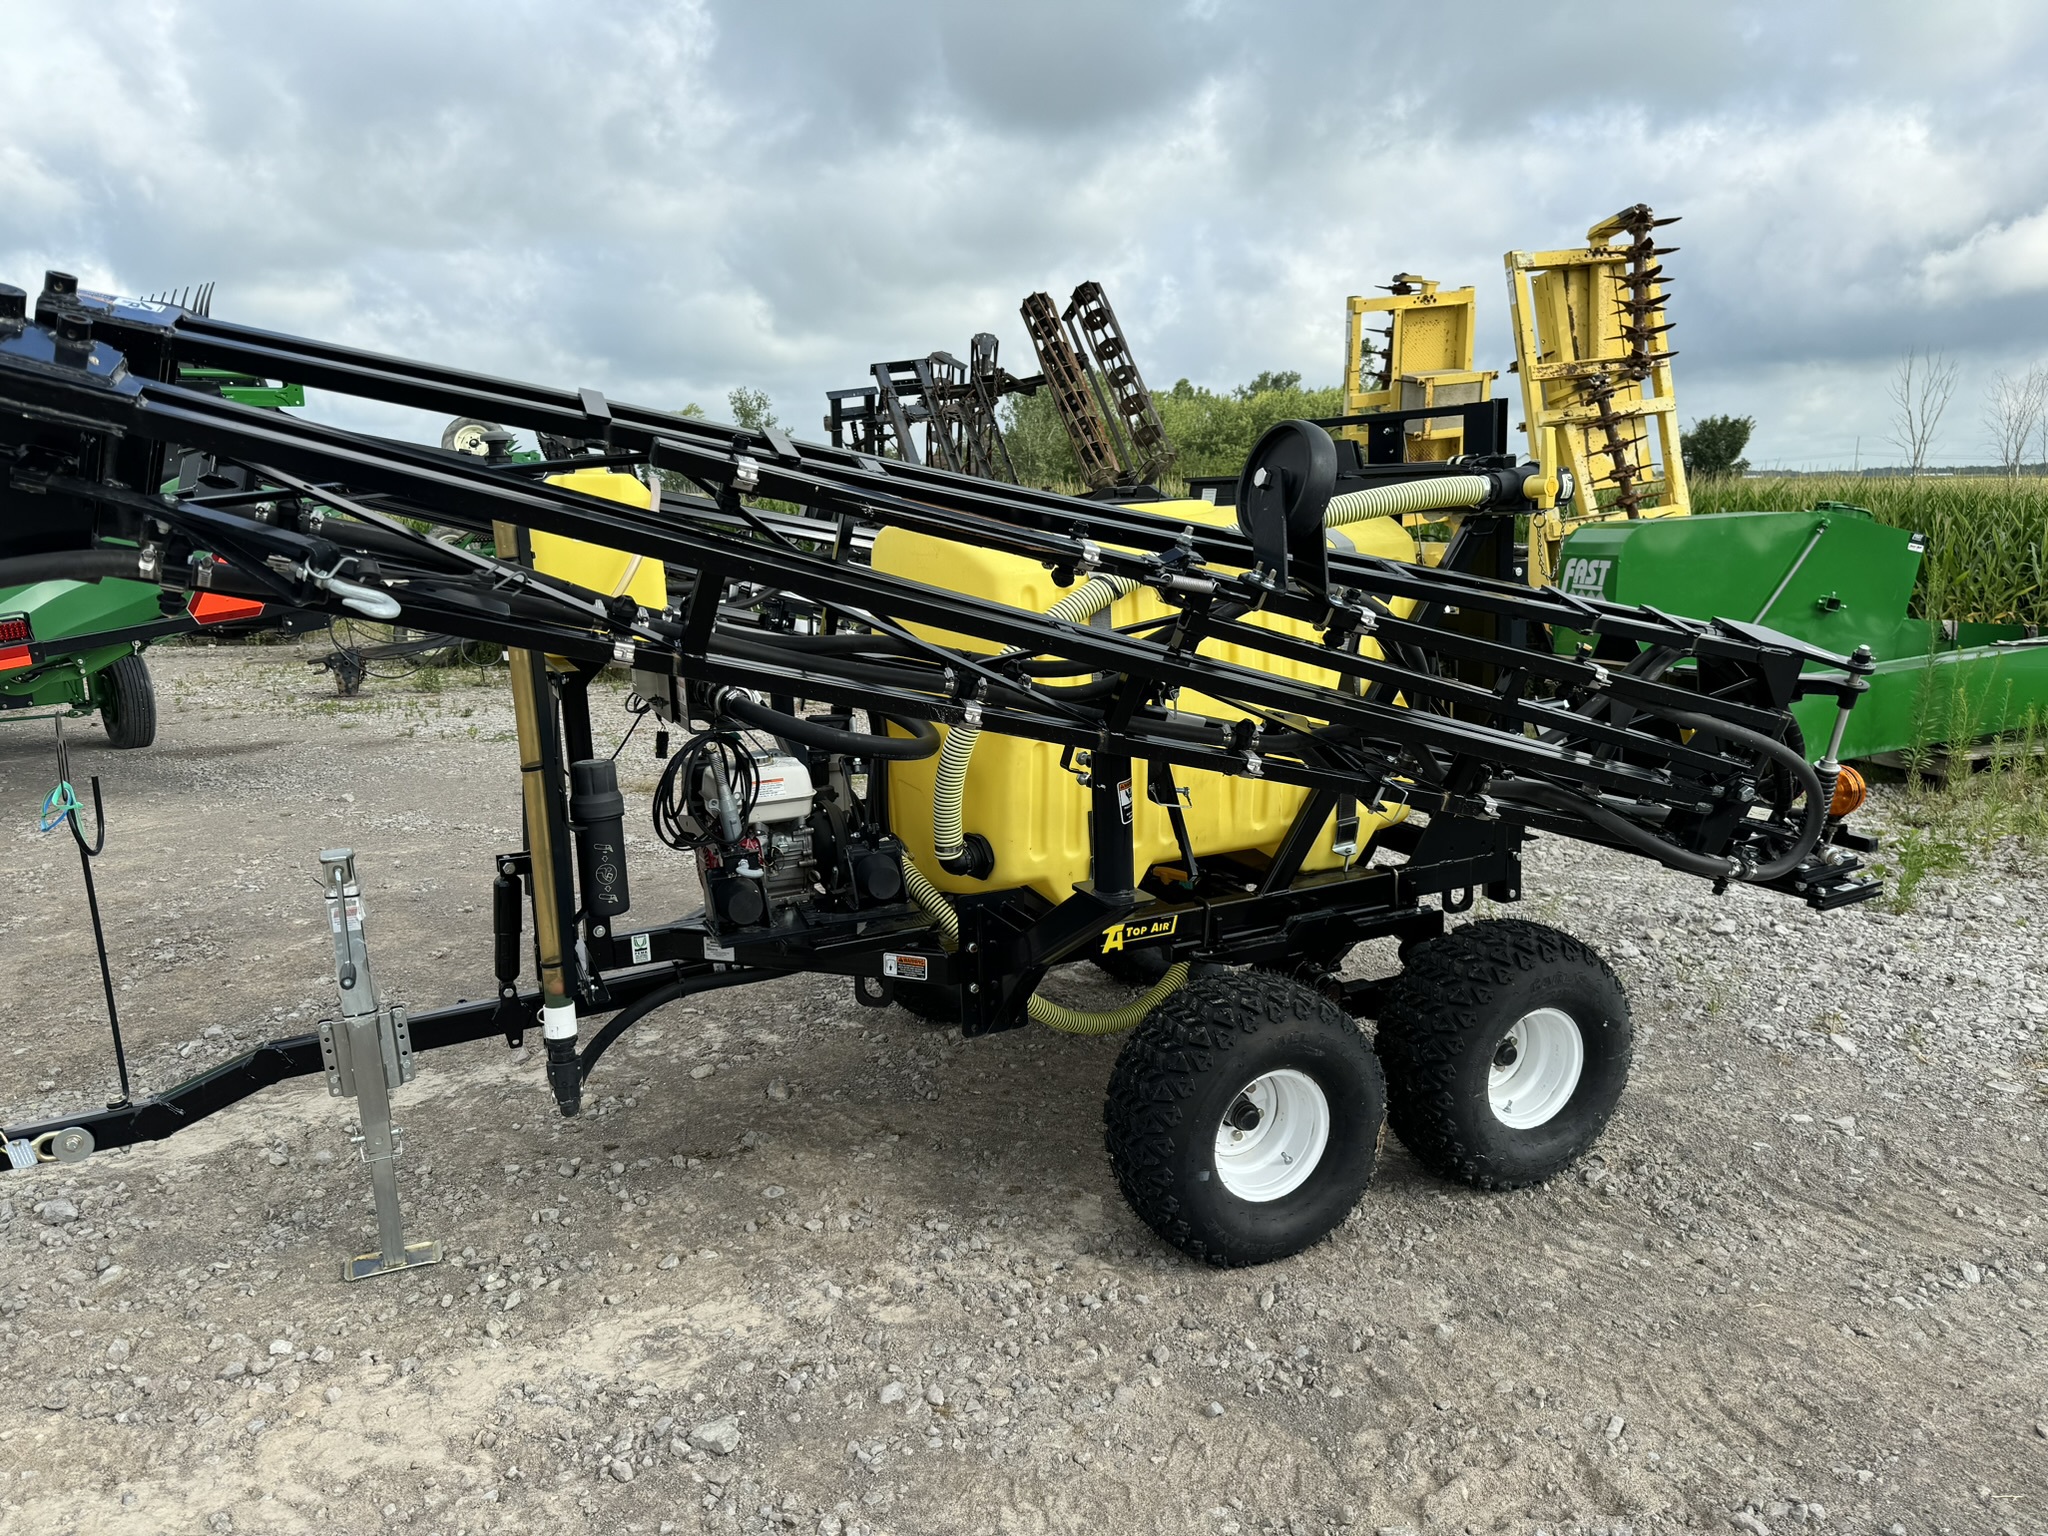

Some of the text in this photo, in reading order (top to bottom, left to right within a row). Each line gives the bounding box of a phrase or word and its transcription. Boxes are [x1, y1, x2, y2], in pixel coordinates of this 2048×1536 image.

[1561, 558, 1612, 593] FAST
[1126, 926, 1147, 937] TOP
[1150, 922, 1170, 933] AIR
